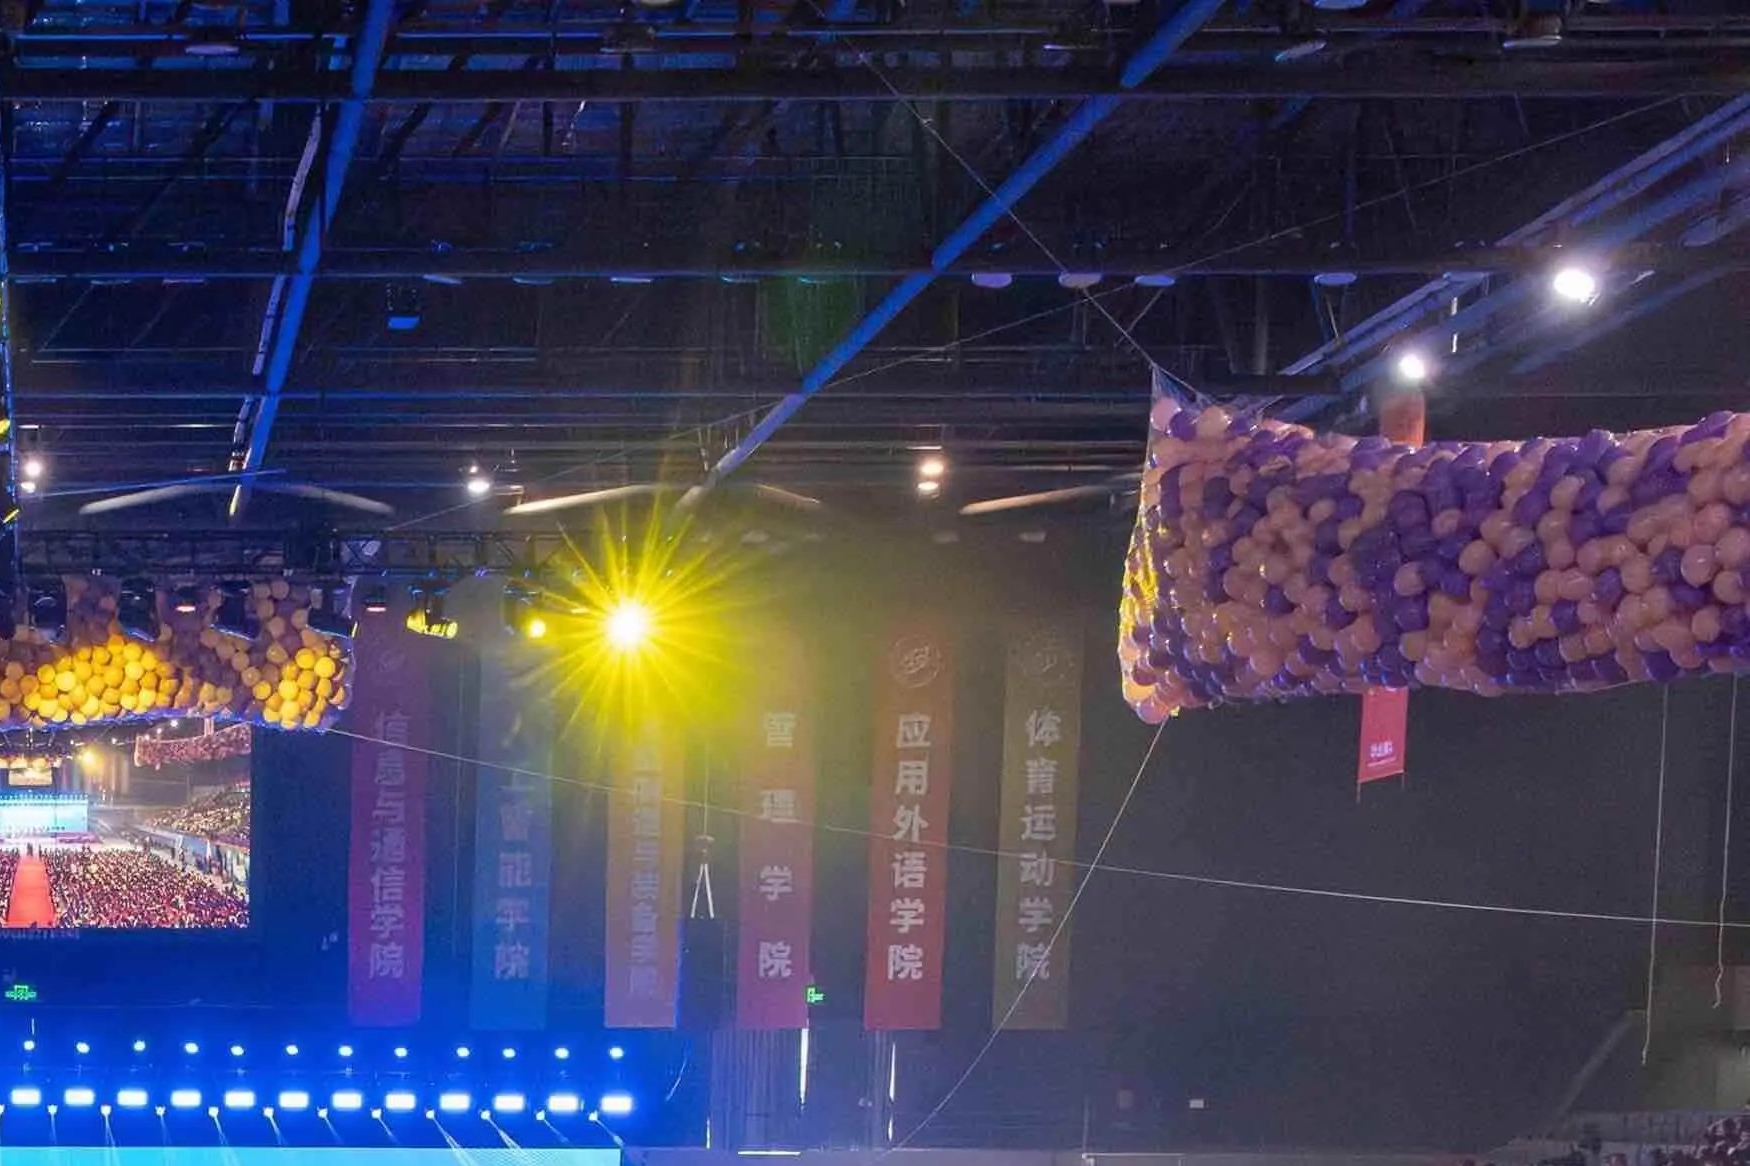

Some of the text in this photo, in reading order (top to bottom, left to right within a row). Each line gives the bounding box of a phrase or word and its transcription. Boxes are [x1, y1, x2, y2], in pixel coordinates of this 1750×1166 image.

[756, 711, 797, 981] 管理学院
[886, 711, 933, 982] 应用外语学院
[1014, 706, 1063, 982] 体育运动学院
